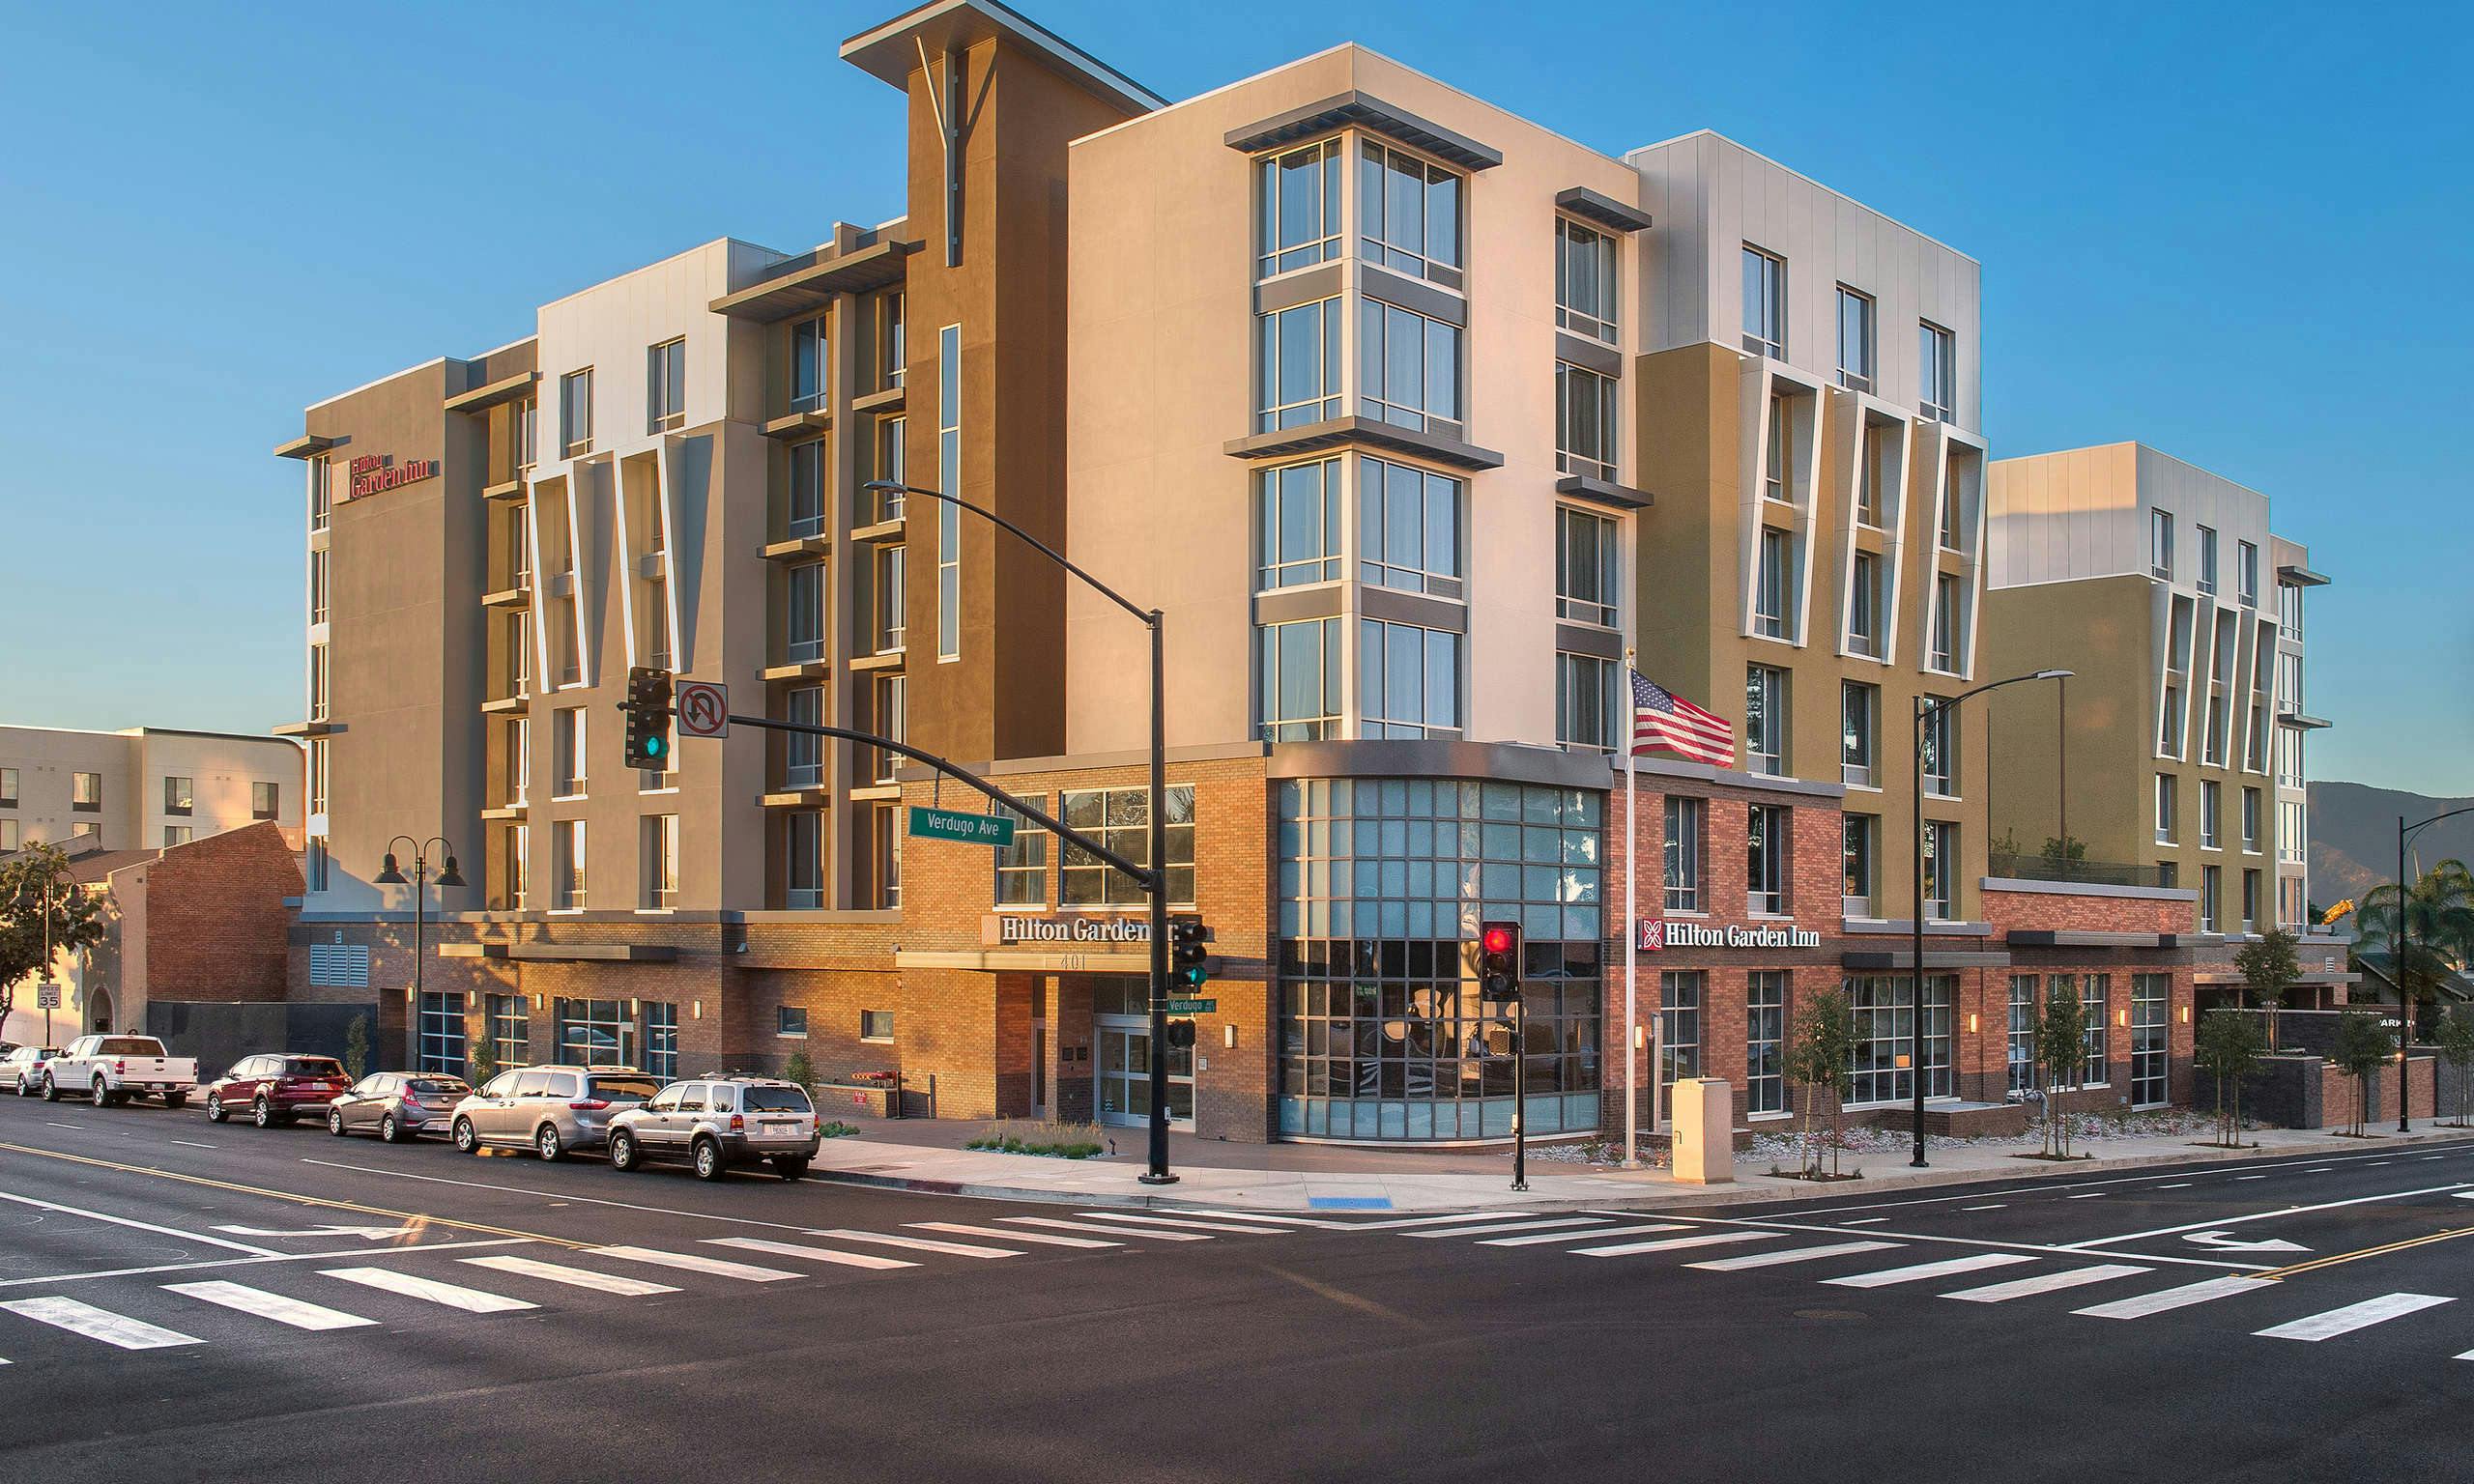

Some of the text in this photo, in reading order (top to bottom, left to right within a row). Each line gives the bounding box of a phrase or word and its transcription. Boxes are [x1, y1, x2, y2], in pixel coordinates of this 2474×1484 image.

[351, 459, 429, 499] Garden Inn
[928, 813, 999, 837] Verdugo Ave
[1002, 917, 1070, 941] Hilton
[1073, 918, 1151, 942] Garden
[1664, 923, 1821, 948] Hilton Garden Inn
[1060, 955, 1085, 970] 401
[40, 996, 59, 1007] 35
[1169, 1000, 1203, 1013] Verdugo
